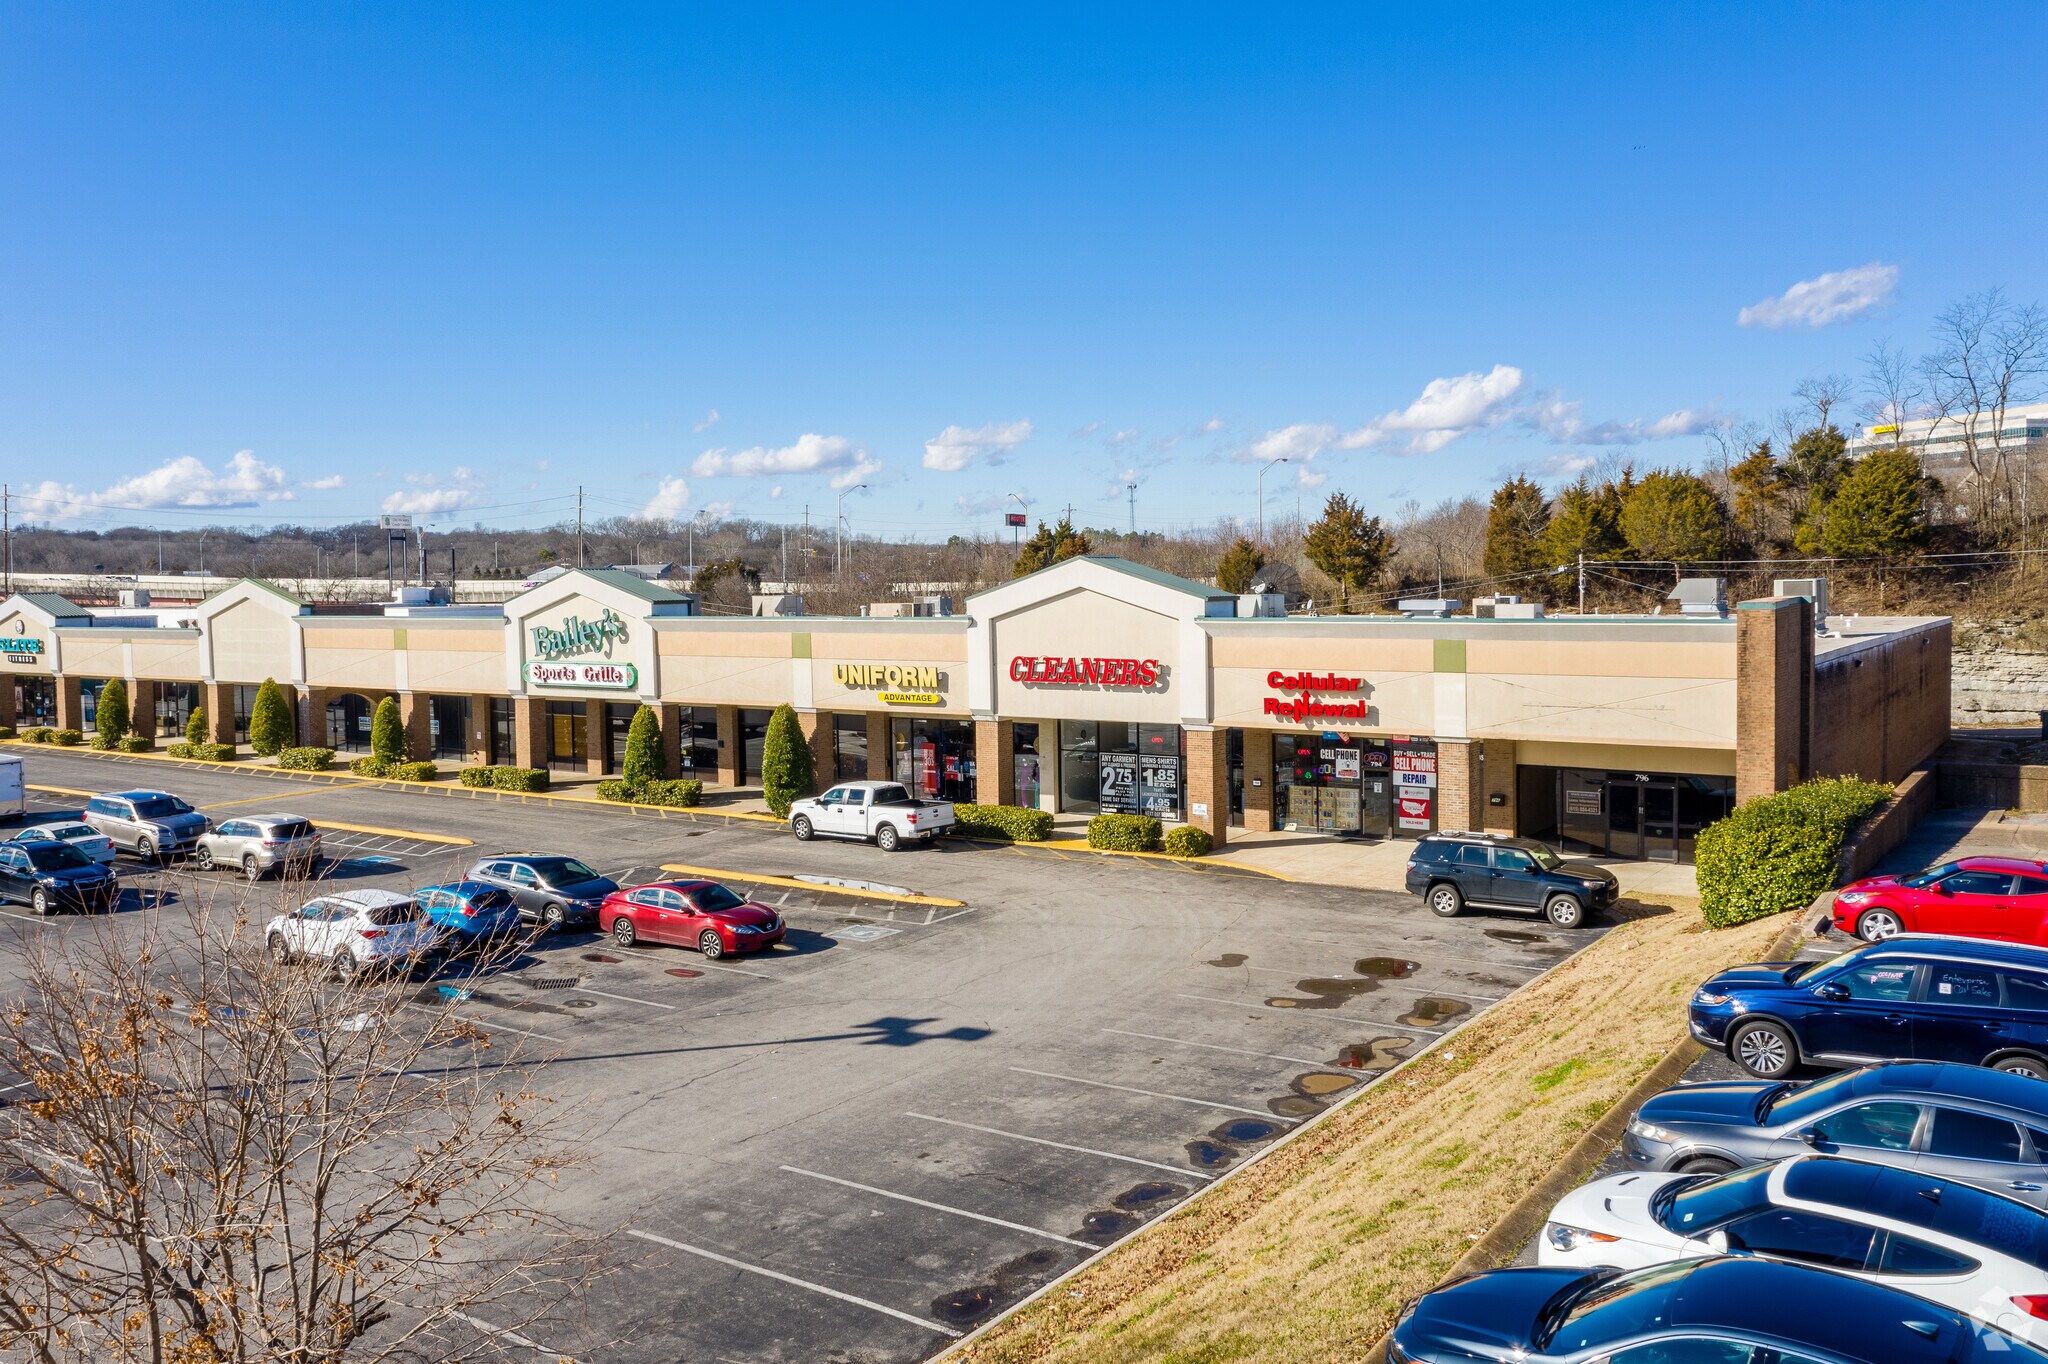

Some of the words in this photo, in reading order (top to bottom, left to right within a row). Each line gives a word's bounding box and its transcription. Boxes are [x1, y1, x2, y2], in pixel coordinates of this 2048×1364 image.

[530, 608, 619, 656] Bailey's
[533, 664, 576, 682] Sports
[583, 666, 622, 683] Grille
[832, 664, 938, 688] UNIFORM
[1009, 655, 1159, 687] CLEANERS
[1267, 671, 1361, 692] Cellular
[884, 693, 933, 702] ADVANTAGE
[1112, 755, 1135, 763] GARMENT
[1320, 748, 1335, 760] CELL
[1336, 749, 1358, 760] PHONE
[1394, 757, 1410, 770] CELL
[1411, 757, 1436, 772] PHONE
[1402, 773, 1427, 784] REPAIR
[1635, 774, 1649, 782] 796
[1971, 986, 1992, 998] Sales
